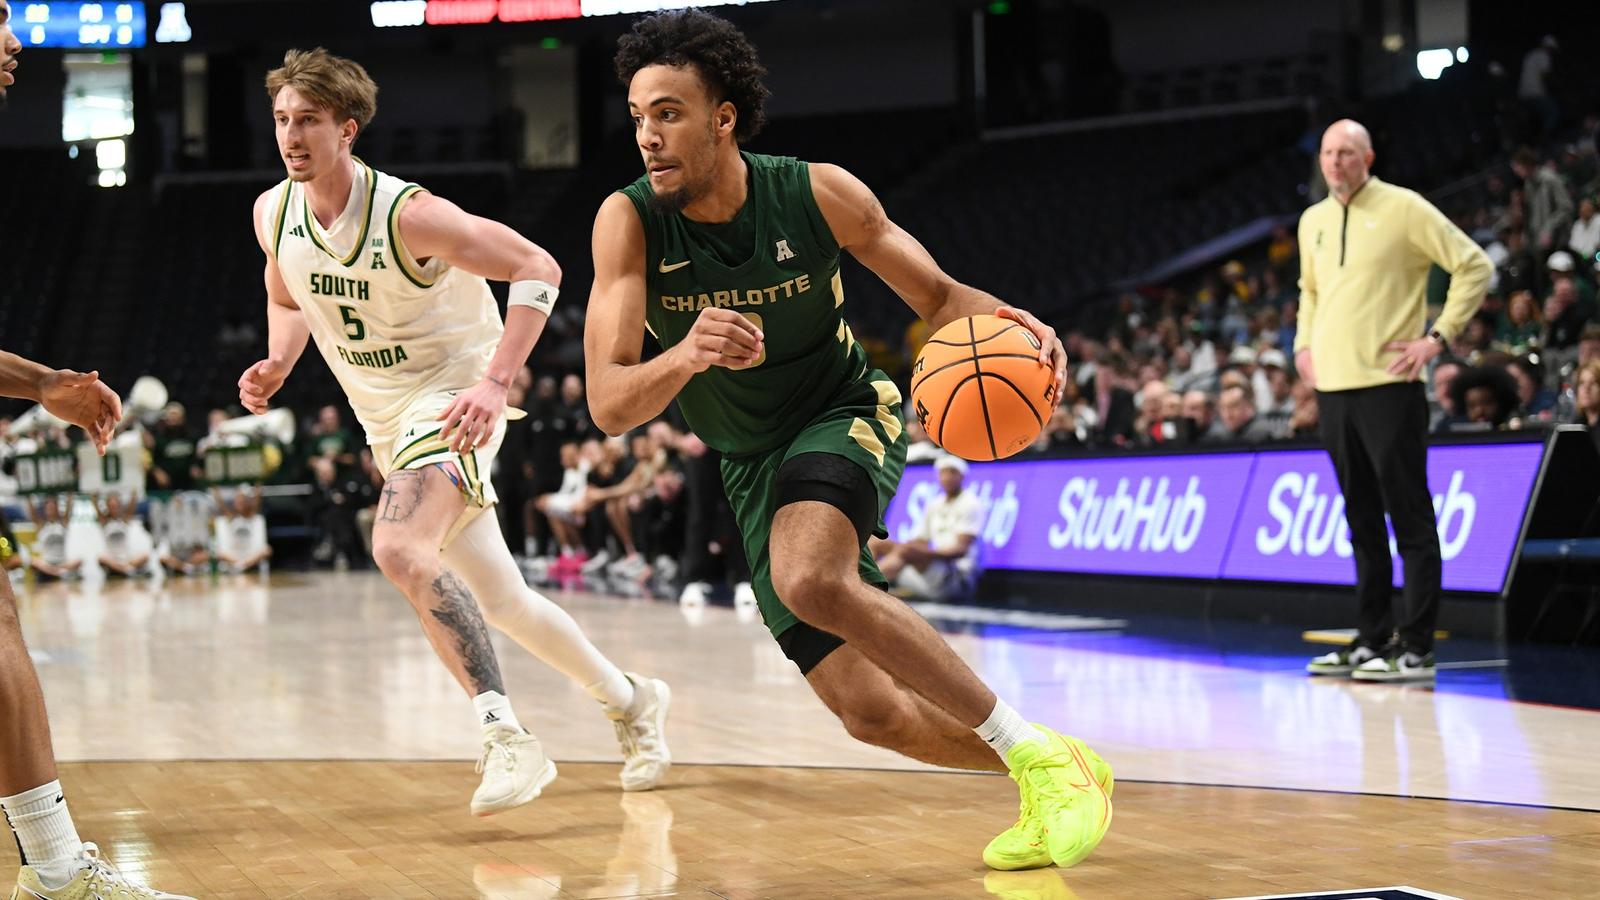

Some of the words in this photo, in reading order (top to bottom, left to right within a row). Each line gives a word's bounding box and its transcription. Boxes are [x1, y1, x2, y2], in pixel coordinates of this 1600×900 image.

[371, 252, 387, 269] A
[776, 239, 796, 262] A
[309, 273, 370, 301] SOUTH
[660, 273, 811, 312] CHARLOTTE
[339, 305, 365, 341] 5
[336, 344, 409, 369] FLORIDA
[1048, 475, 1207, 553] StubHub
[1256, 469, 1477, 561] Stub
